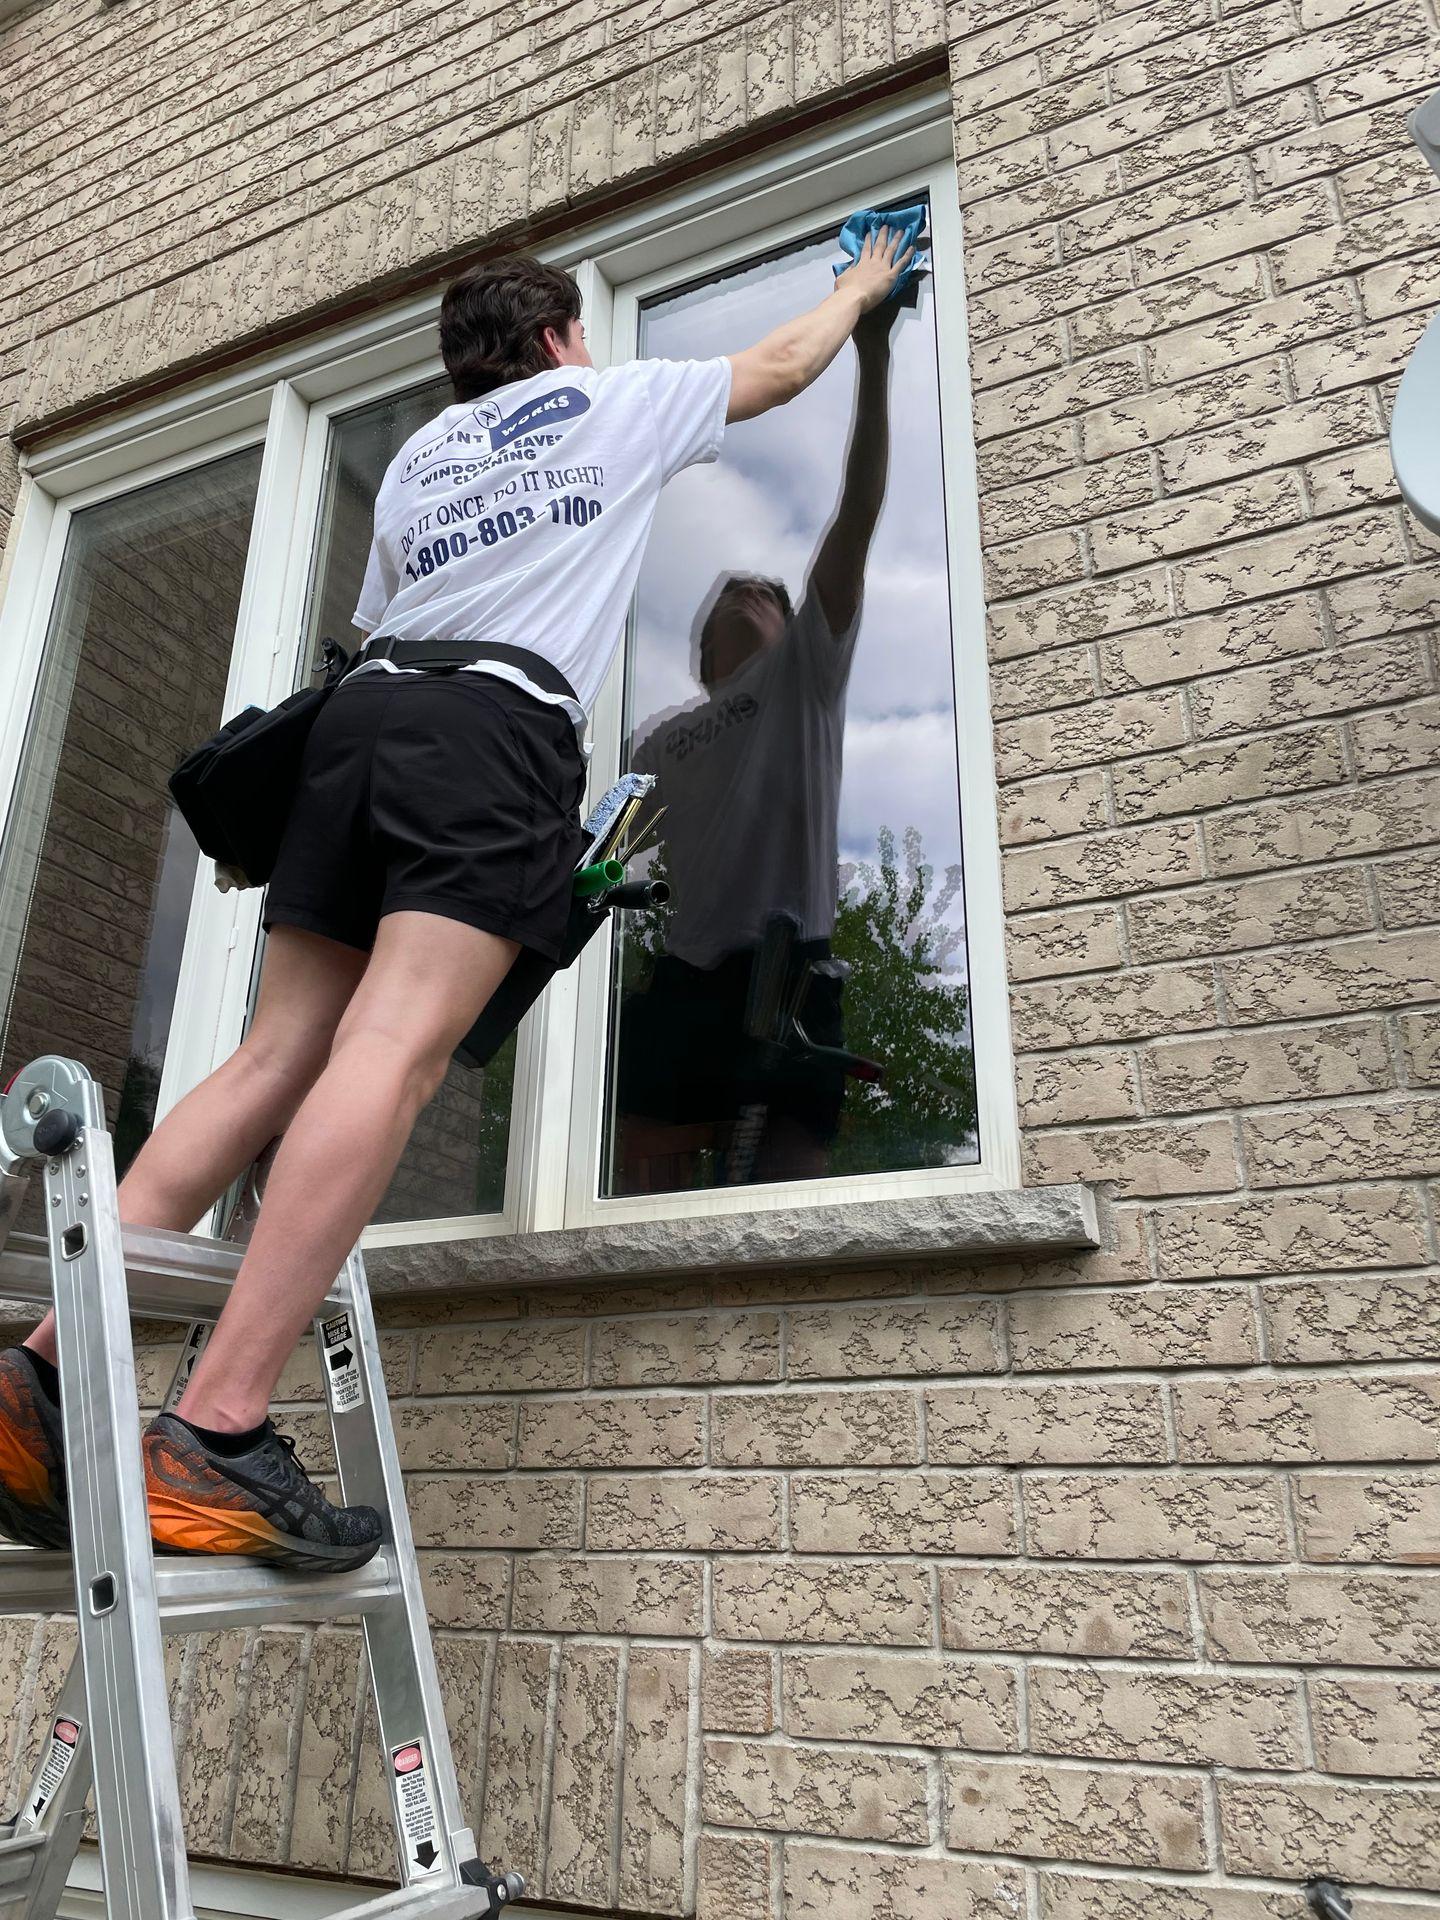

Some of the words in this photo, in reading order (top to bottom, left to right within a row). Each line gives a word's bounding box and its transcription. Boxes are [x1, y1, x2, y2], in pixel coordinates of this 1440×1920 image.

[501, 395, 570, 437] WORKS
[420, 456, 493, 487] WINDOW
[453, 449, 537, 485] CLEANING
[401, 527, 415, 555] DO
[418, 512, 432, 536] IT
[494, 480, 517, 504] DO
[521, 470, 541, 492] IT
[544, 466, 604, 490] RIGHT!
